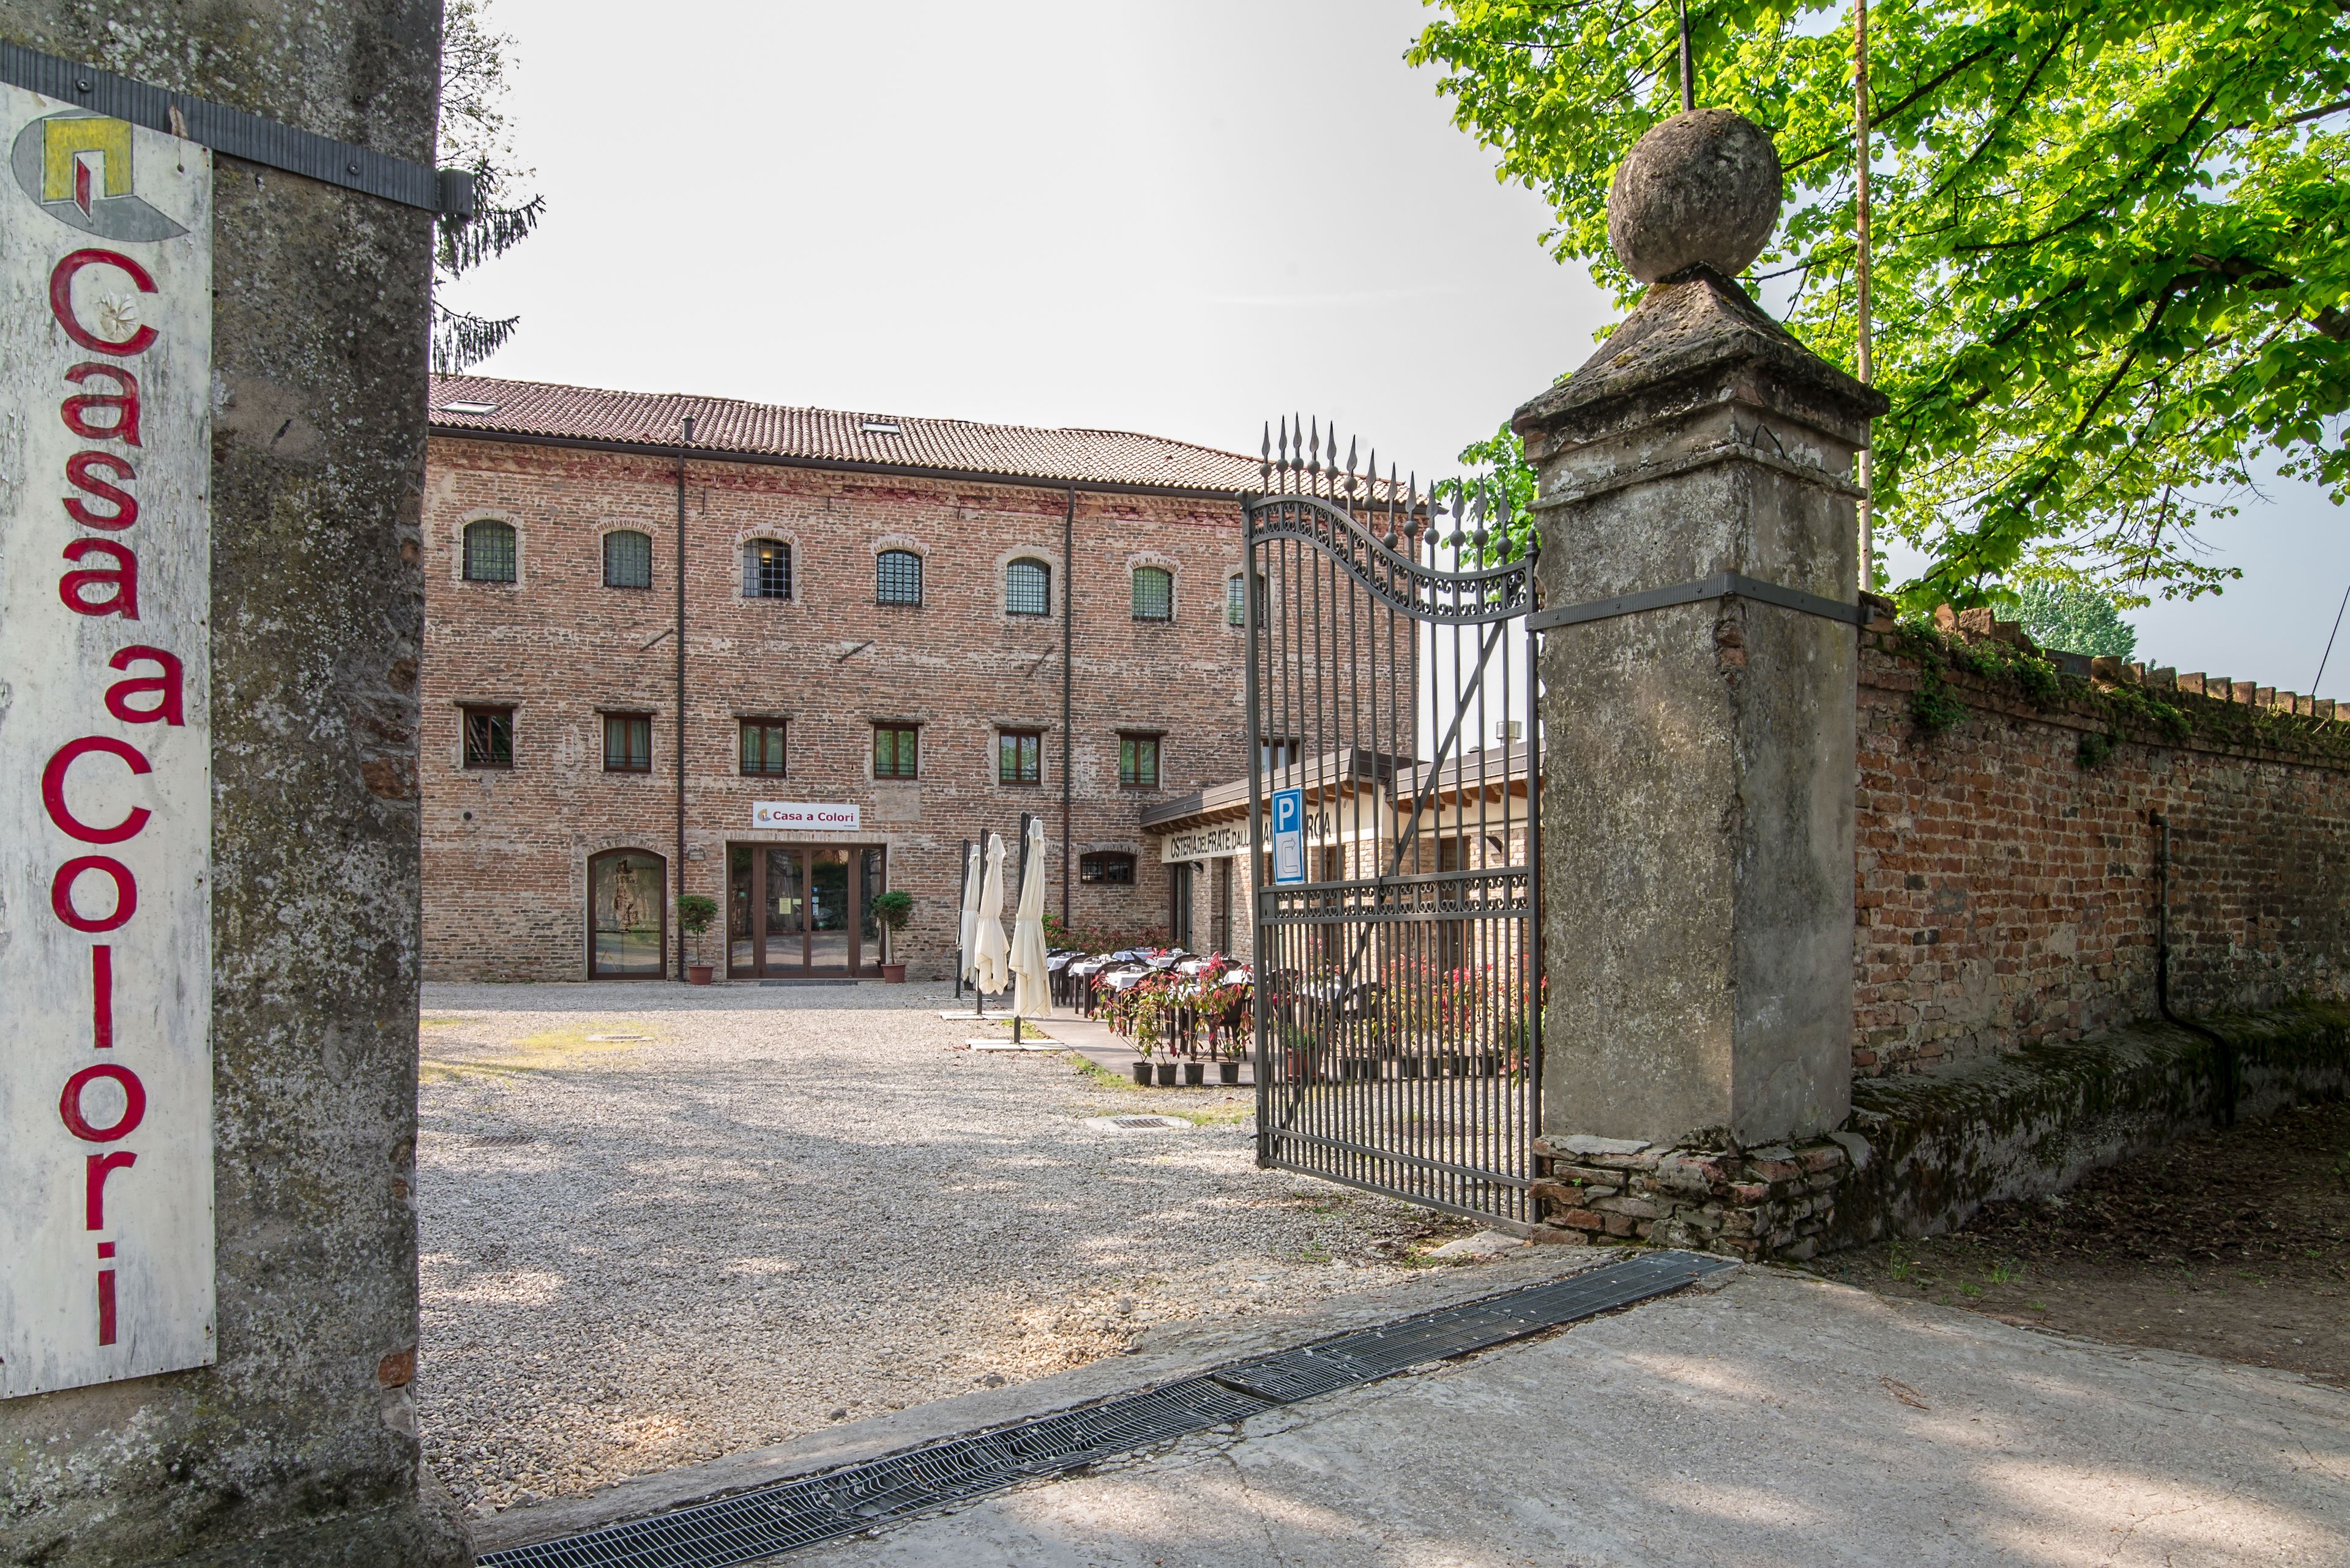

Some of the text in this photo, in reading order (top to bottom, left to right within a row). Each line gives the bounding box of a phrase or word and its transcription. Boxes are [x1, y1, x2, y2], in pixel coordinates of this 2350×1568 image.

[42, 248, 185, 1345] Casa a Colori
[773, 811, 802, 821] Casa
[818, 812, 854, 823] Colori
[1279, 797, 1294, 831] P
[1171, 835, 1197, 858] OSTERIA
[1198, 836, 1207, 854] DEL
[1207, 828, 1230, 853] FRATE
[1232, 829, 1250, 849] DALL
